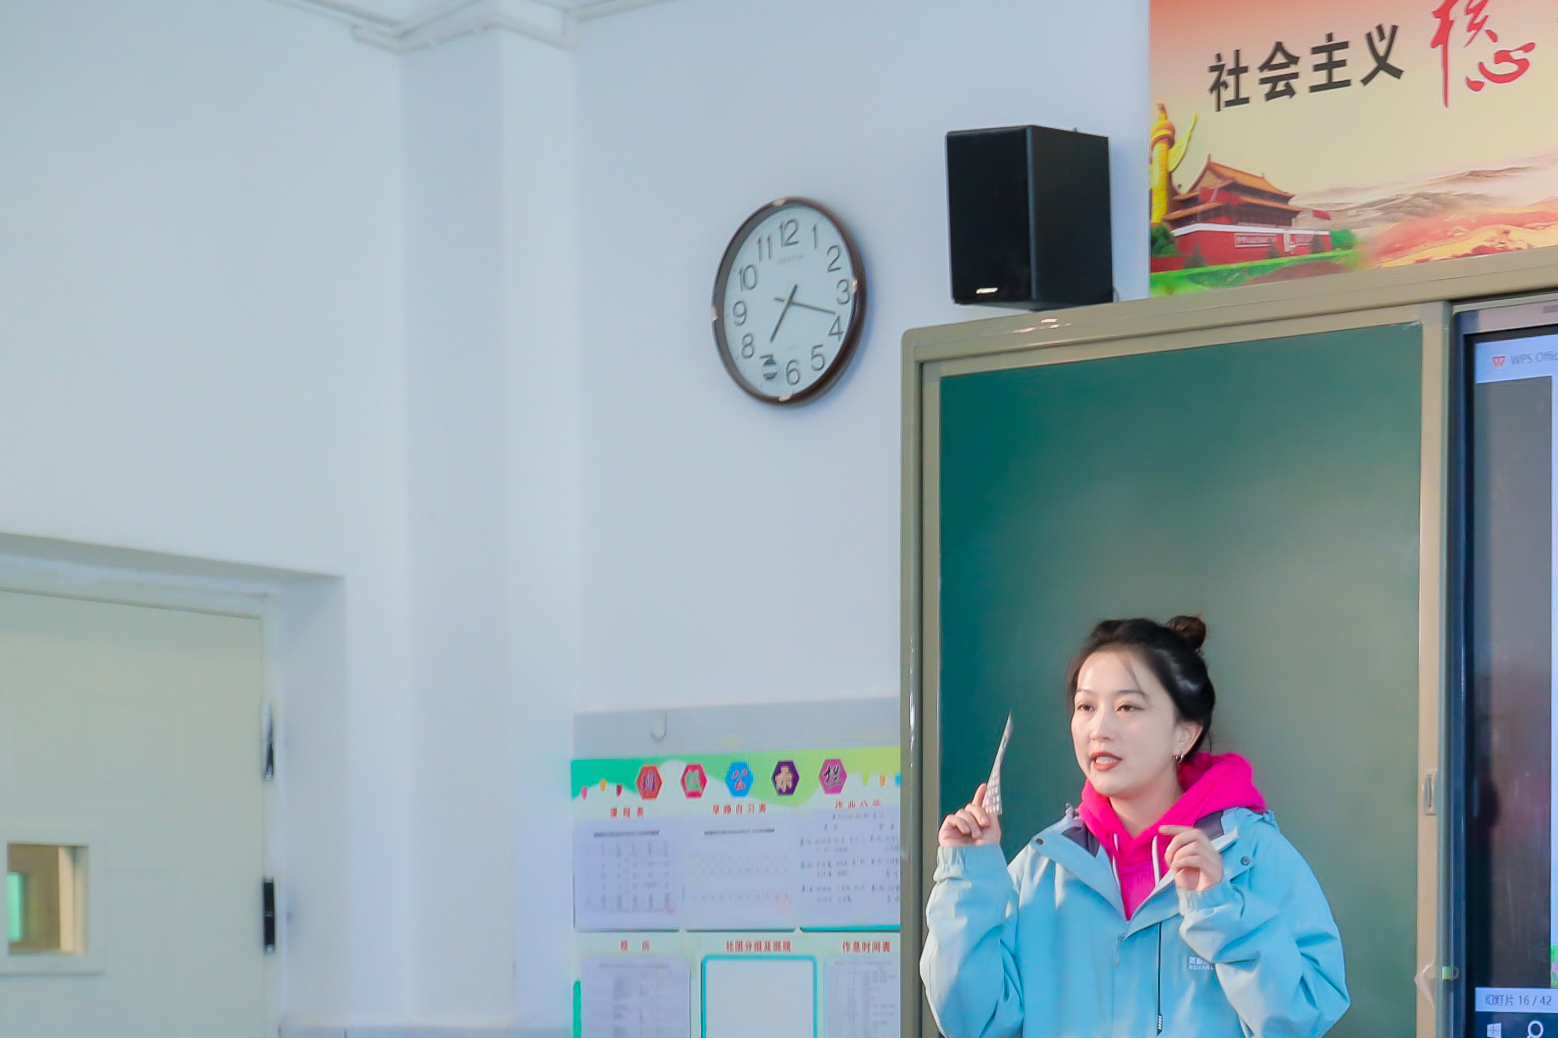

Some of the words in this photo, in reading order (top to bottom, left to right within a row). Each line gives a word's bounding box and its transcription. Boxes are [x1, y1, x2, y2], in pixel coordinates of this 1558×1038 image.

[1208, 24, 1404, 112] 社会主义
[779, 218, 799, 247] 12
[812, 224, 819, 249] 1
[757, 234, 773, 262] 11
[827, 245, 841, 272] 2
[737, 264, 758, 292] 10
[836, 279, 851, 305] 3
[732, 301, 747, 326] 9
[829, 316, 844, 342] 4
[741, 333, 755, 359] 8
[811, 345, 826, 371] 5
[785, 360, 801, 385] 6
[1518, 995, 1530, 1006] 16
[1540, 995, 1552, 1006] 42
